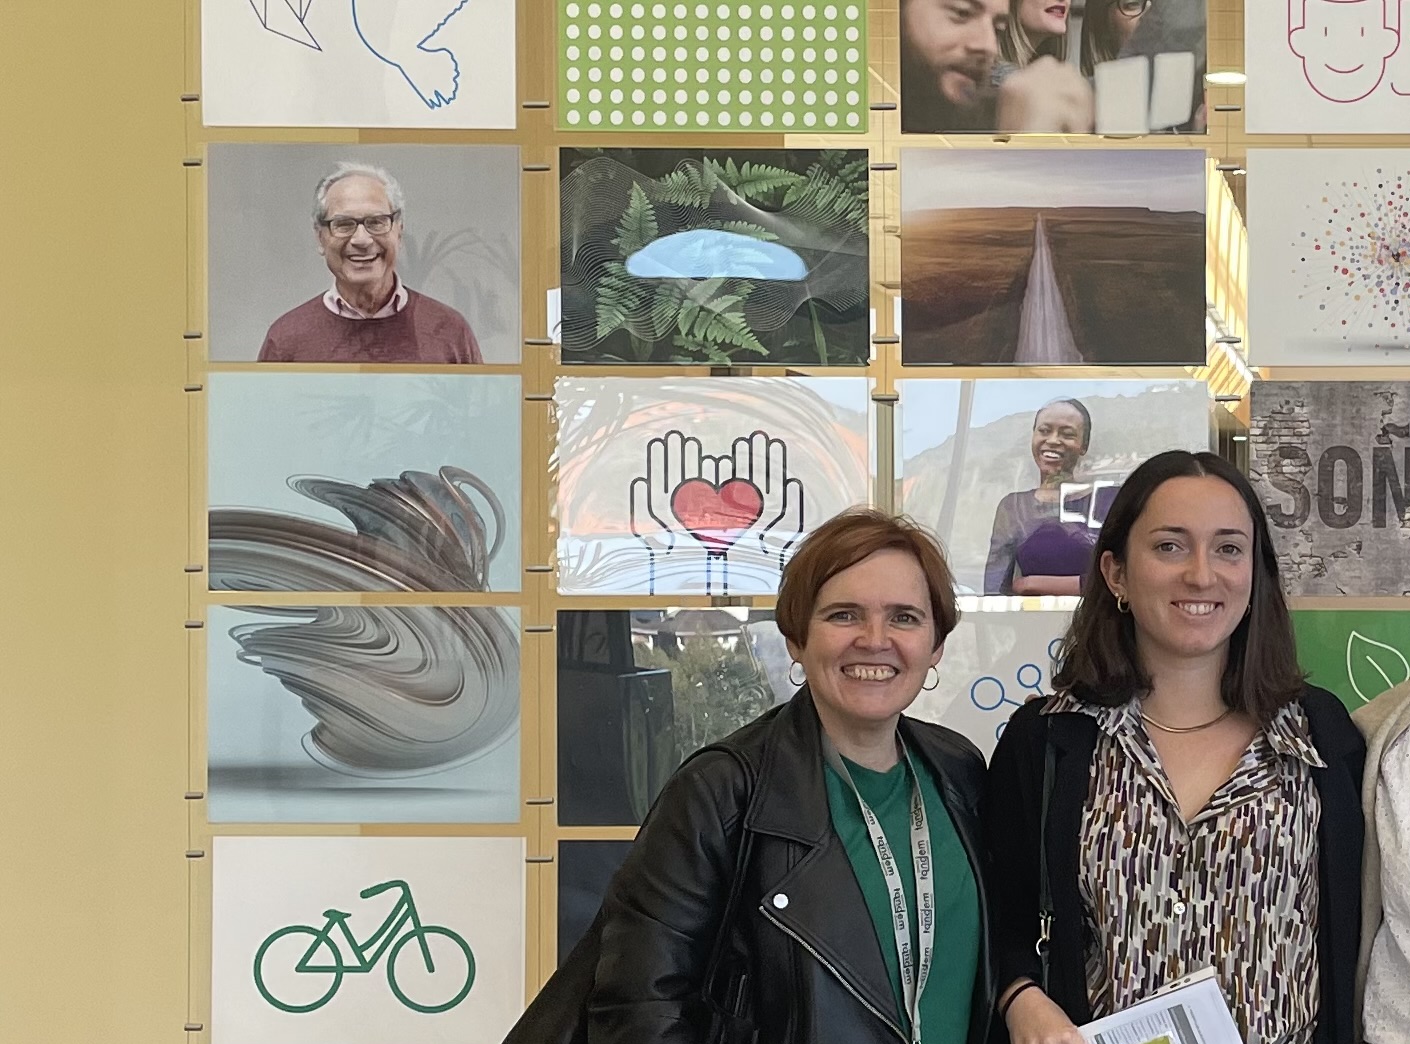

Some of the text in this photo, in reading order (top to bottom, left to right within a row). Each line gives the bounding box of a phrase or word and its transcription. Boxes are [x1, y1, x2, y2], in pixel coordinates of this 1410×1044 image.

[877, 836, 895, 877] tandem
[915, 839, 930, 880] tandem
[893, 887, 906, 931] tandem
[920, 892, 933, 934] tandem
